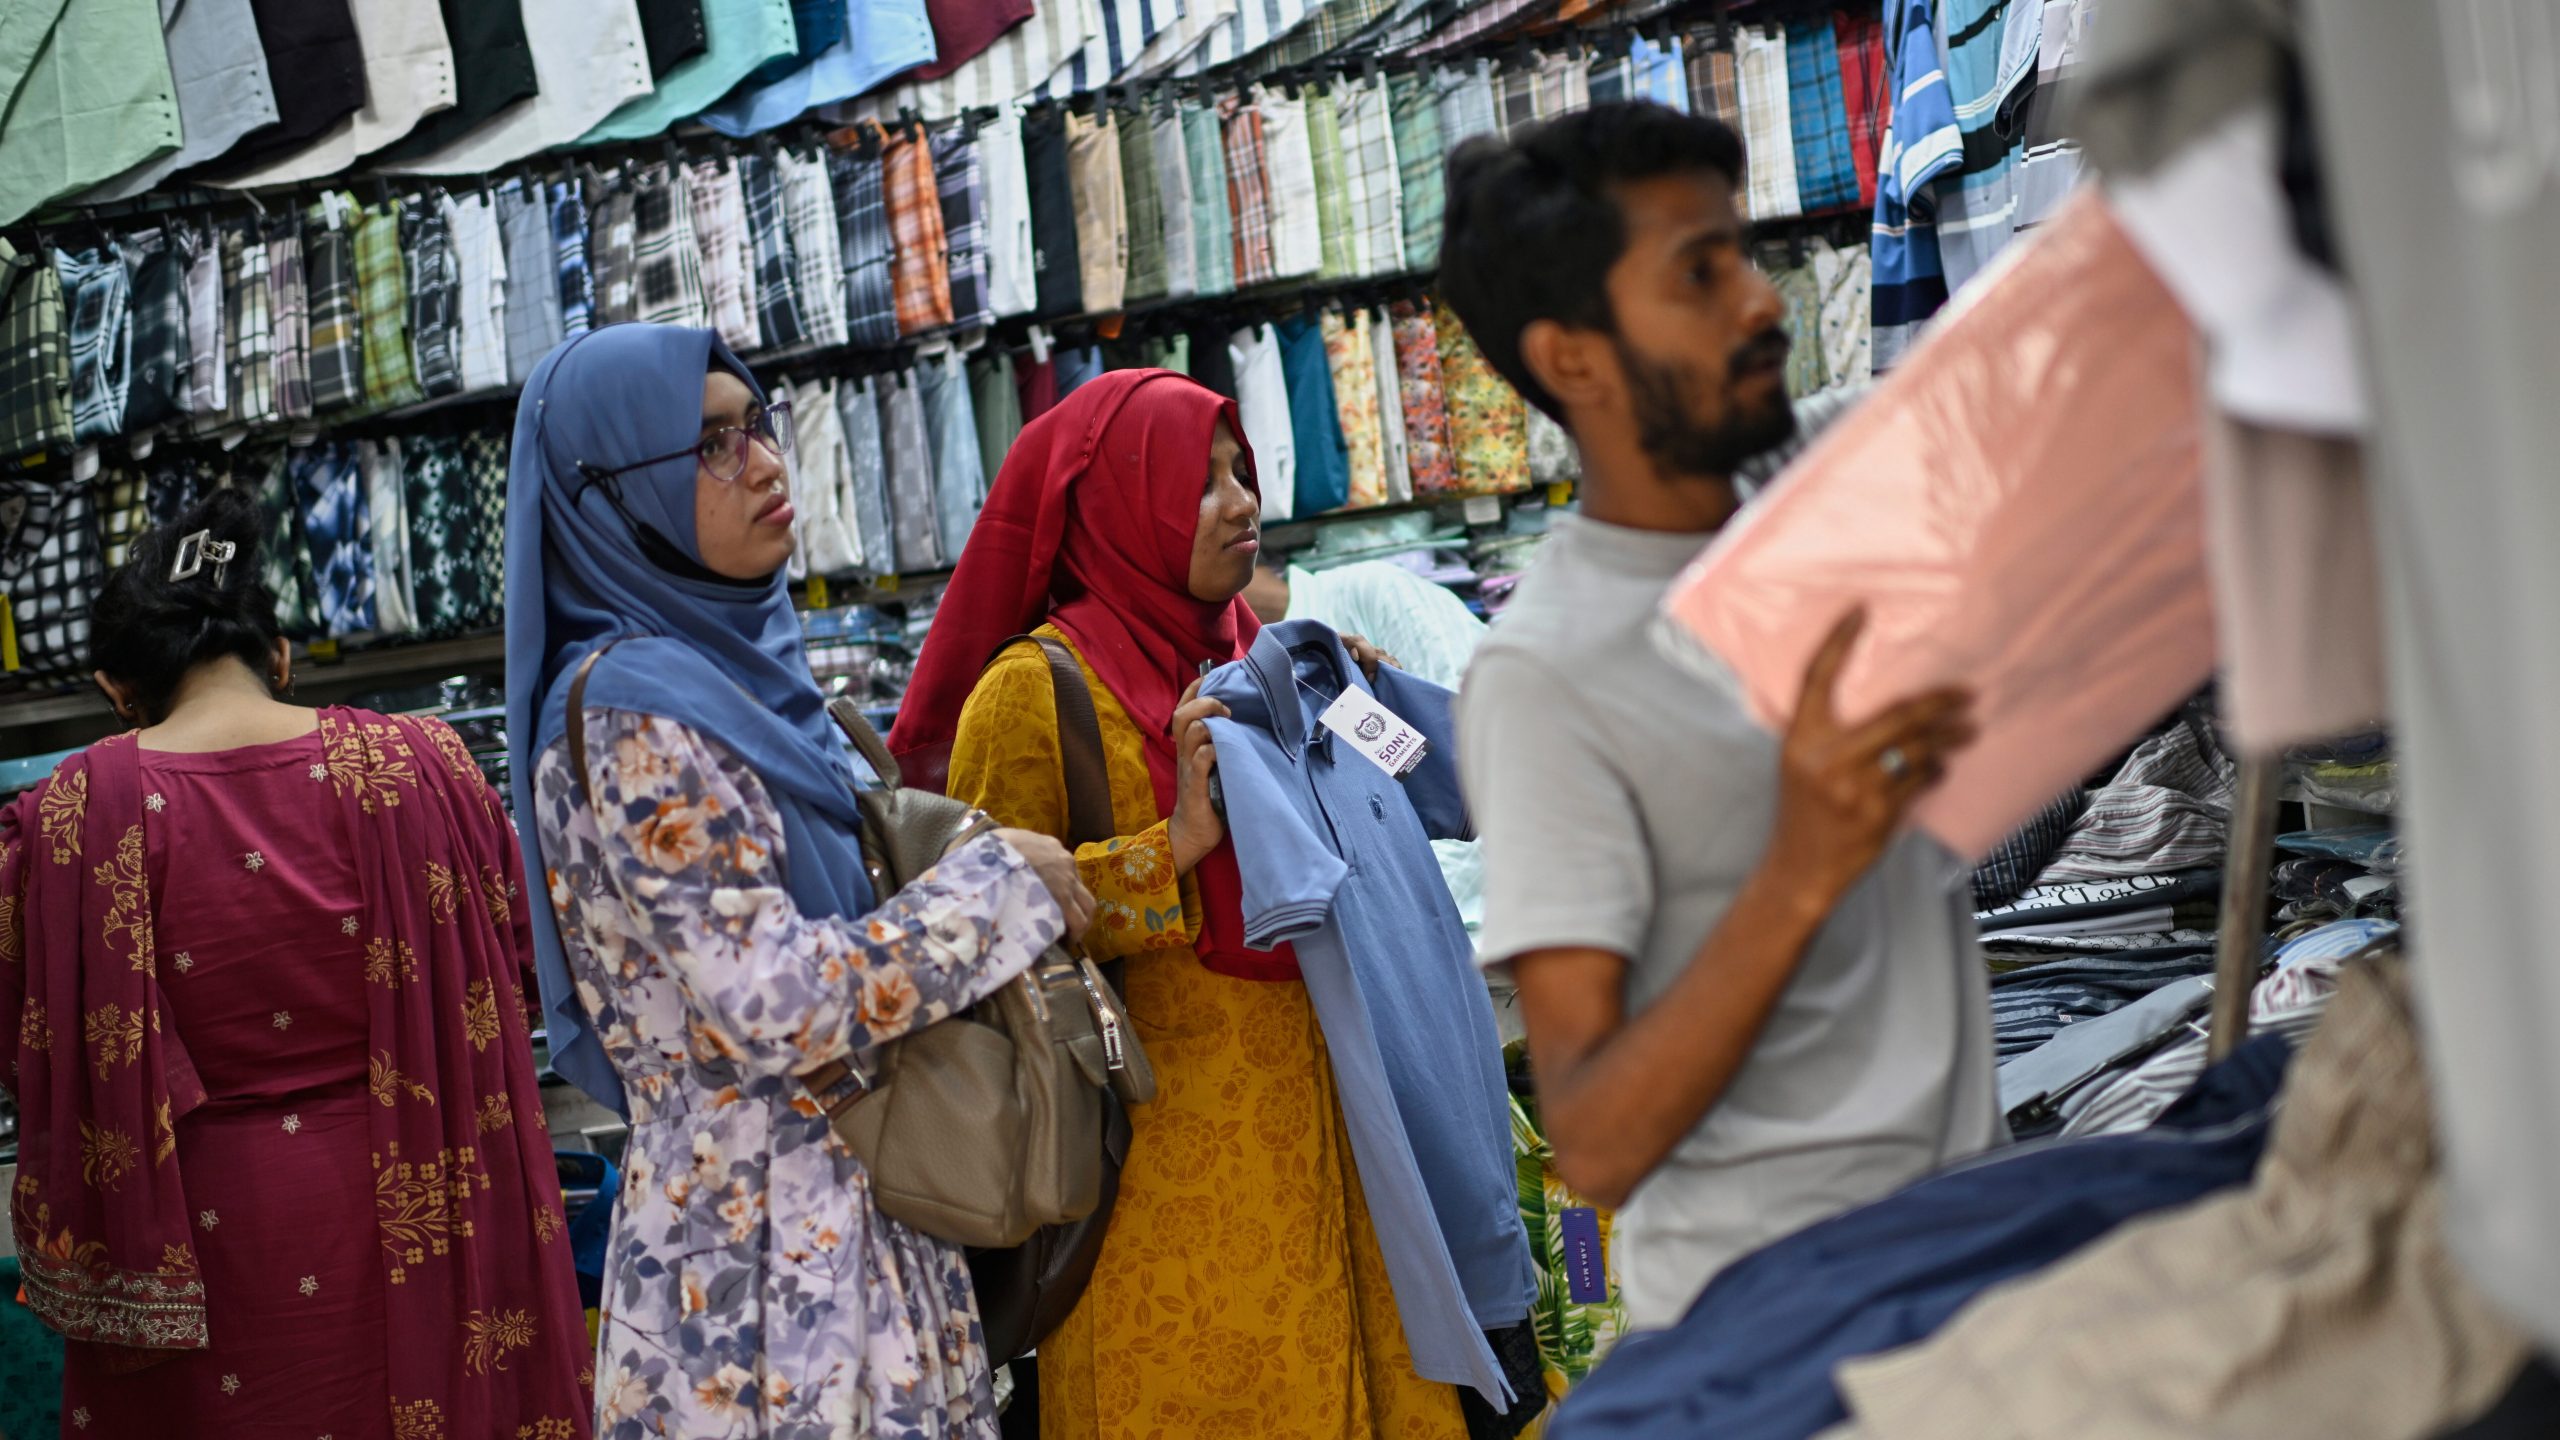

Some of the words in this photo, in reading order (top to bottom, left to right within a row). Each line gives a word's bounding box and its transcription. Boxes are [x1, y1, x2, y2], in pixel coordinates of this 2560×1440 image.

[1379, 728, 1410, 762] SONY
[1389, 737, 1417, 767] GARMENTS
[1580, 1241, 1588, 1266] ZARA
[1583, 1268, 1591, 1288] MAN
